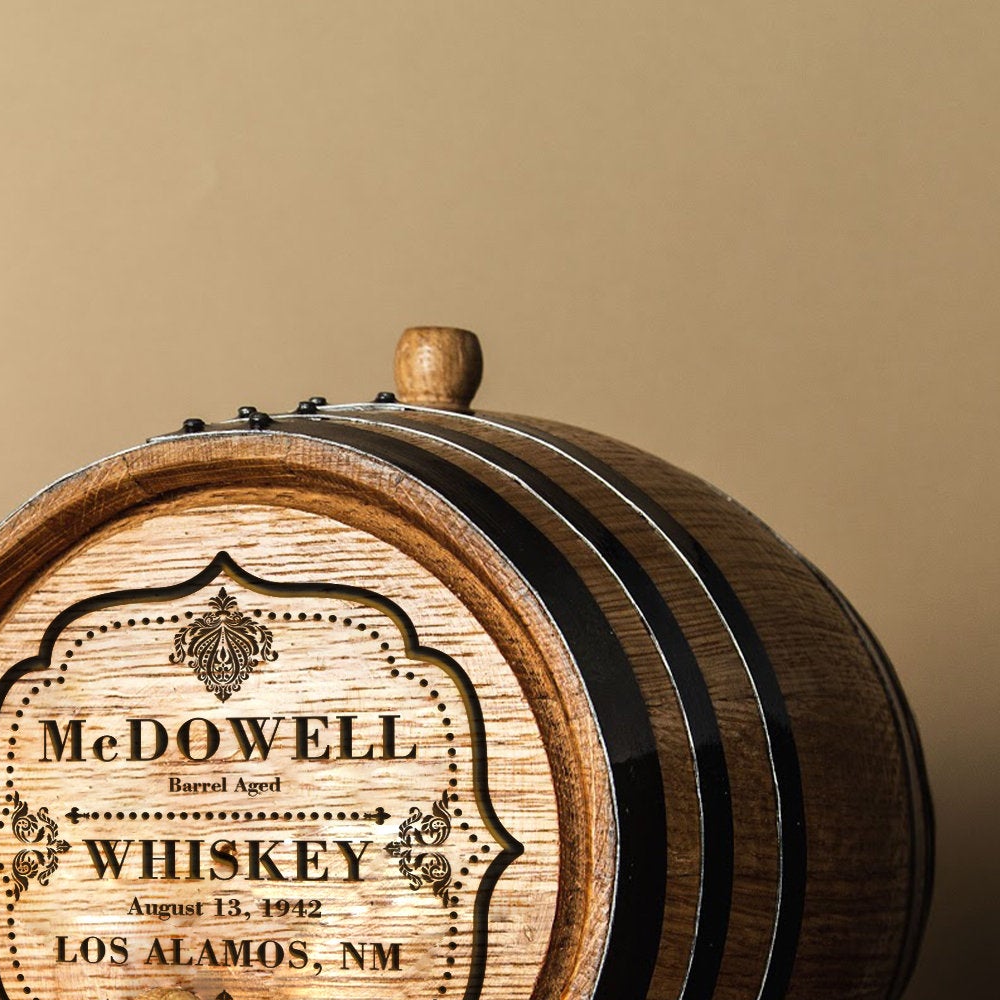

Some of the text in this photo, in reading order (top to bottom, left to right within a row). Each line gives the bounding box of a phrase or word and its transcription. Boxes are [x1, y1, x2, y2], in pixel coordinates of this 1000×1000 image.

[38, 714, 417, 762] McDOWELL
[168, 777, 281, 795] Barrel Aged
[82, 838, 373, 882] WHISKEY
[127, 897, 322, 921] August 13, 1942
[55, 936, 403, 976] LOS ALAMOS, NM
